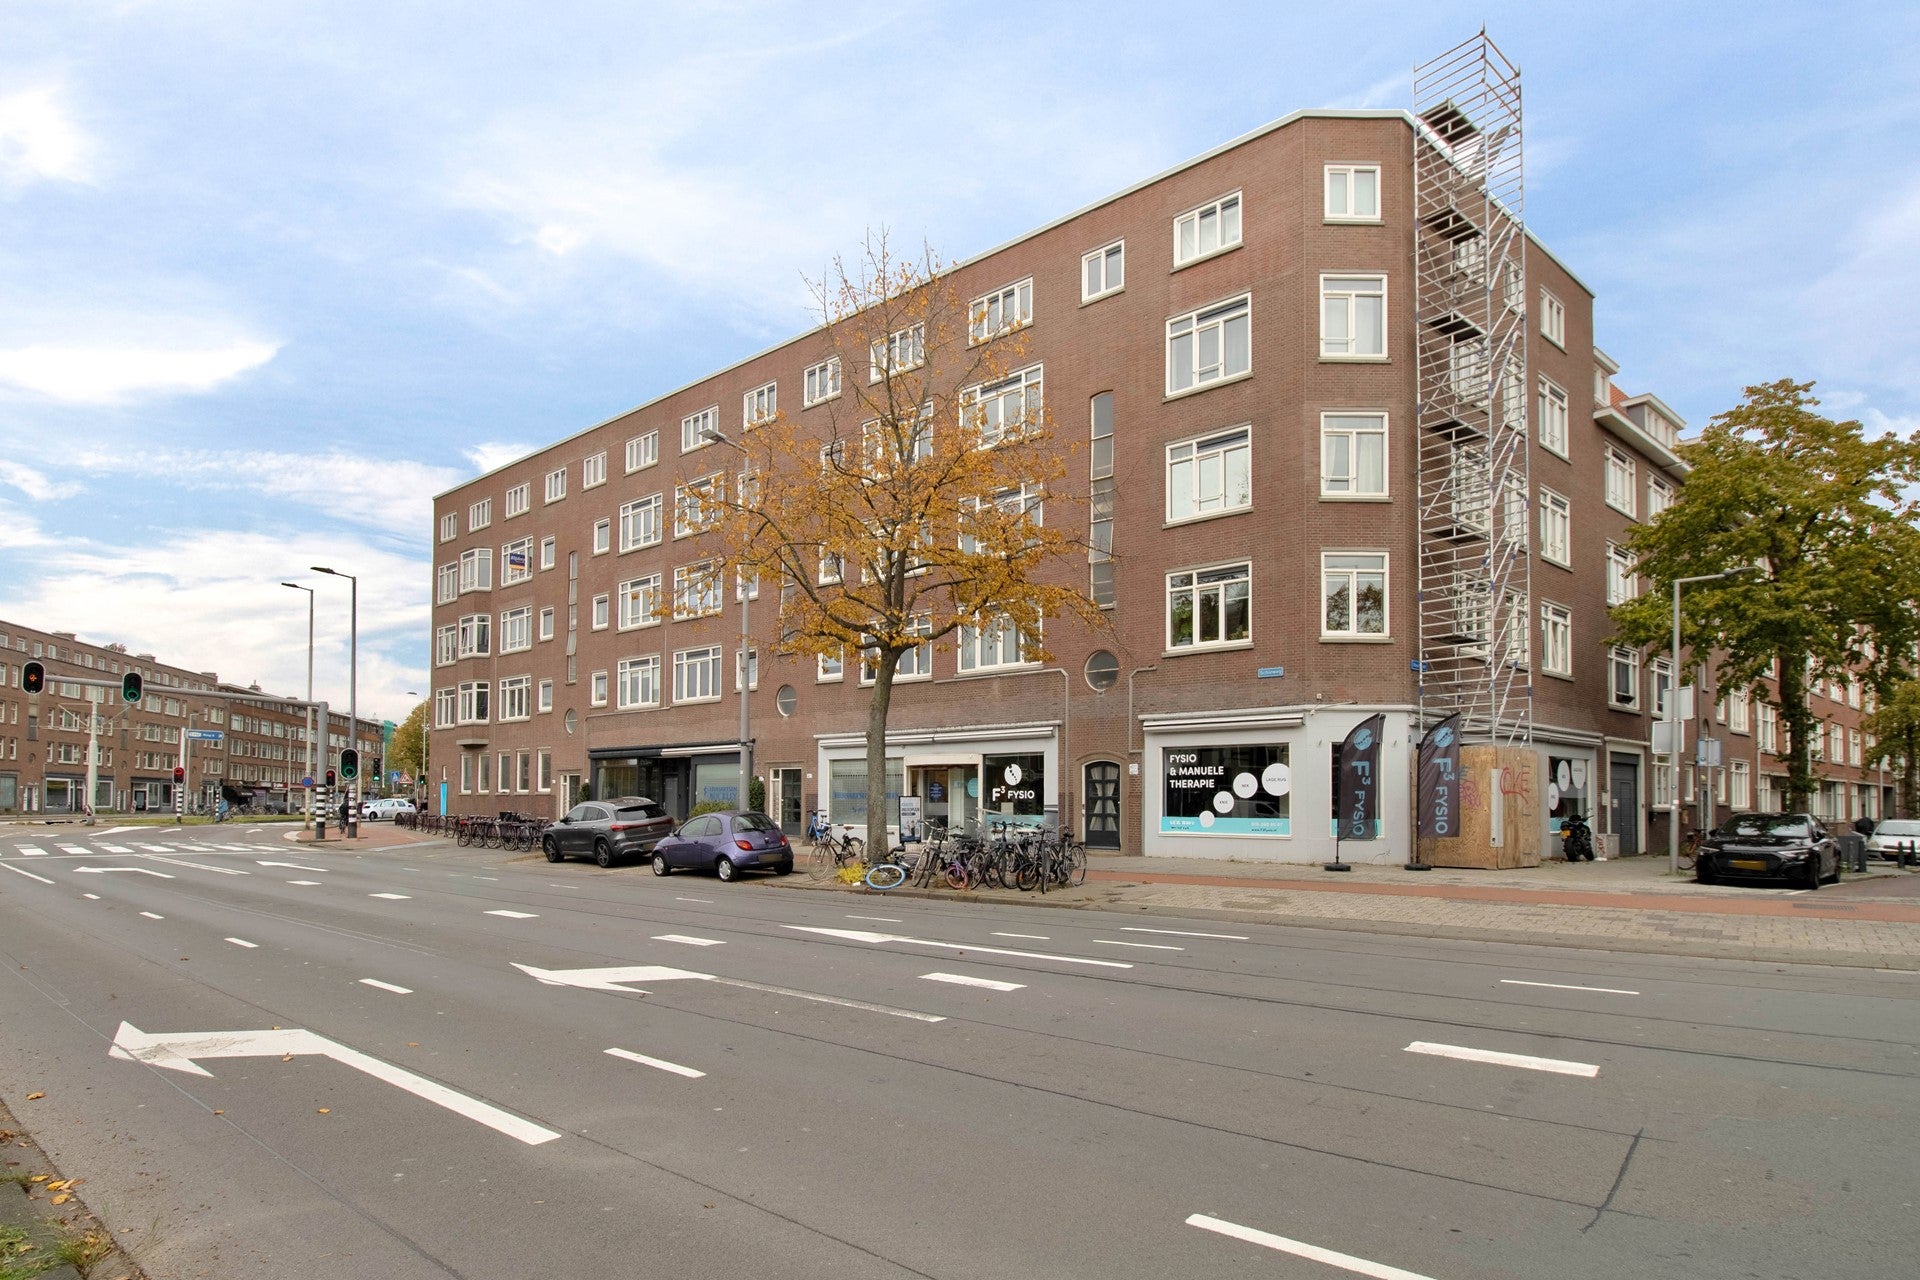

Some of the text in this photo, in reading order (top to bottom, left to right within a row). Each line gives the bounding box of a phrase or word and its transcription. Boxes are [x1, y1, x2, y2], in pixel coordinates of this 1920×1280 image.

[1169, 754, 1197, 763] FYSIO
[1169, 766, 1224, 776] & MANUELE
[1169, 779, 1215, 788] THERAPIE
[1008, 790, 1035, 799] FYSIO
[1352, 790, 1366, 836] FYSIO
[1435, 786, 1448, 834] FYSIO
